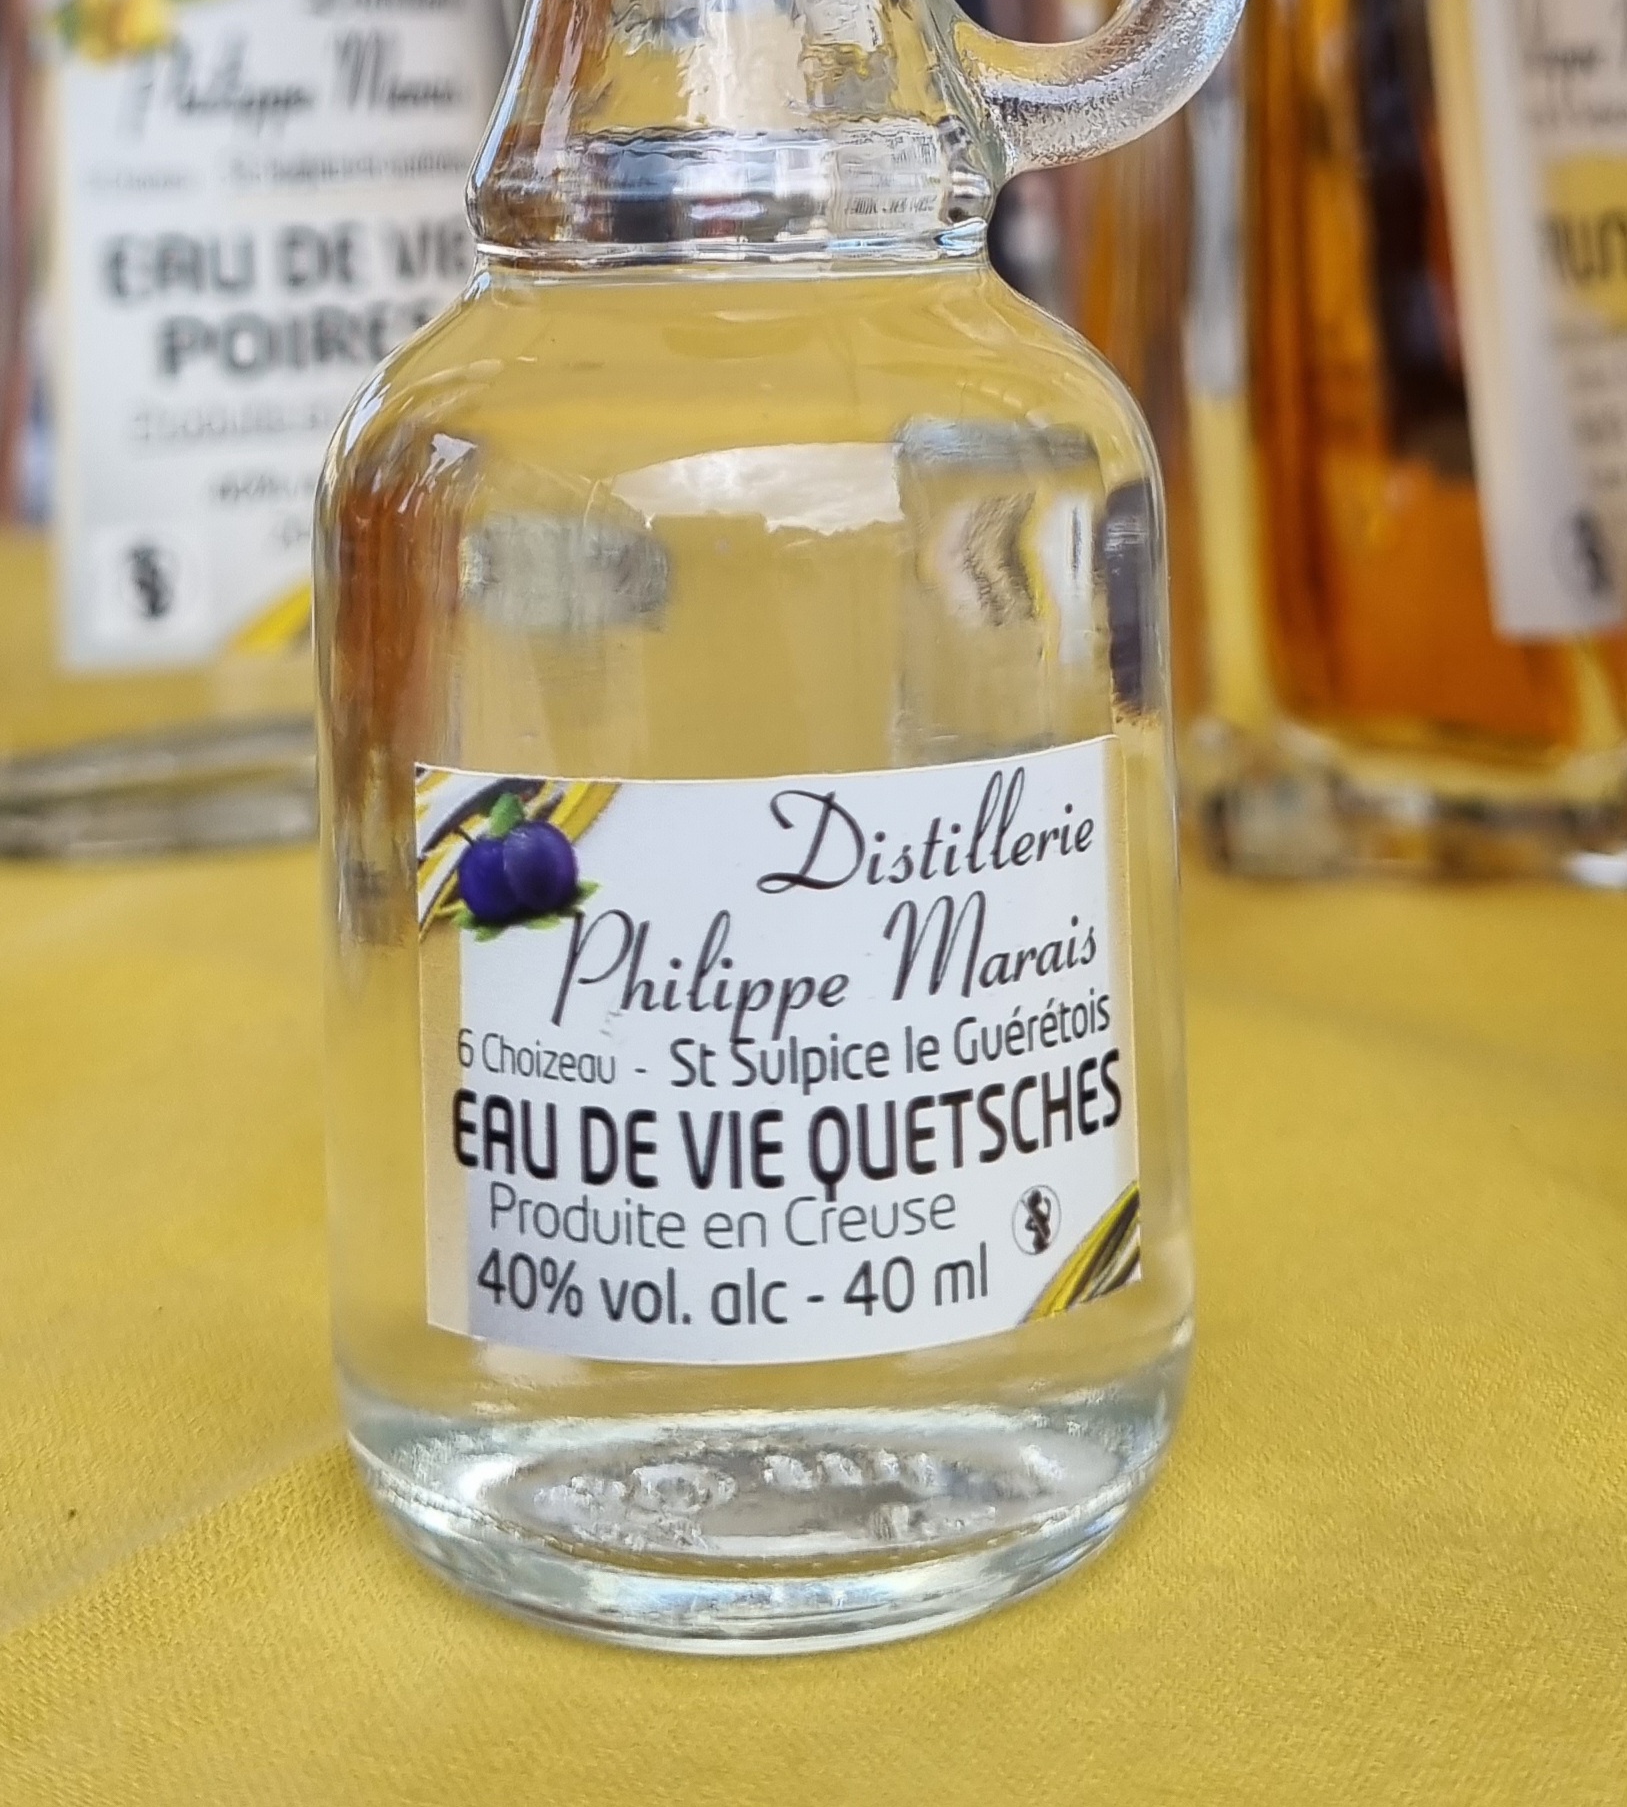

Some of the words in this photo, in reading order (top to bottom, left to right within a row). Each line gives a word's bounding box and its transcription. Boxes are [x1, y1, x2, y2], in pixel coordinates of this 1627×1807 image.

[105, 234, 256, 298] EAU
[276, 224, 358, 289] DE
[756, 767, 1095, 893] Distillerie
[551, 909, 850, 1040] Philippe
[884, 890, 1096, 1000] Marais
[457, 1028, 474, 1068] 6
[482, 1033, 616, 1084] Choizeau
[670, 1038, 718, 1087] St
[731, 1032, 890, 1094] Sulpice
[904, 1025, 940, 1074] le
[953, 988, 1111, 1066] Guérétois
[452, 1089, 558, 1179] EAU
[579, 1107, 659, 1189] DE
[679, 1108, 786, 1190] VIE
[808, 1048, 1123, 1203] QUETSCHES
[489, 1181, 686, 1249] Produite
[703, 1210, 767, 1249] en
[785, 1191, 957, 1248] Creuse
[477, 1247, 584, 1318] 40%
[599, 1265, 692, 1326] vol.
[711, 1267, 788, 1326] alc
[844, 1256, 915, 1316] 40
[934, 1241, 989, 1306] ml
